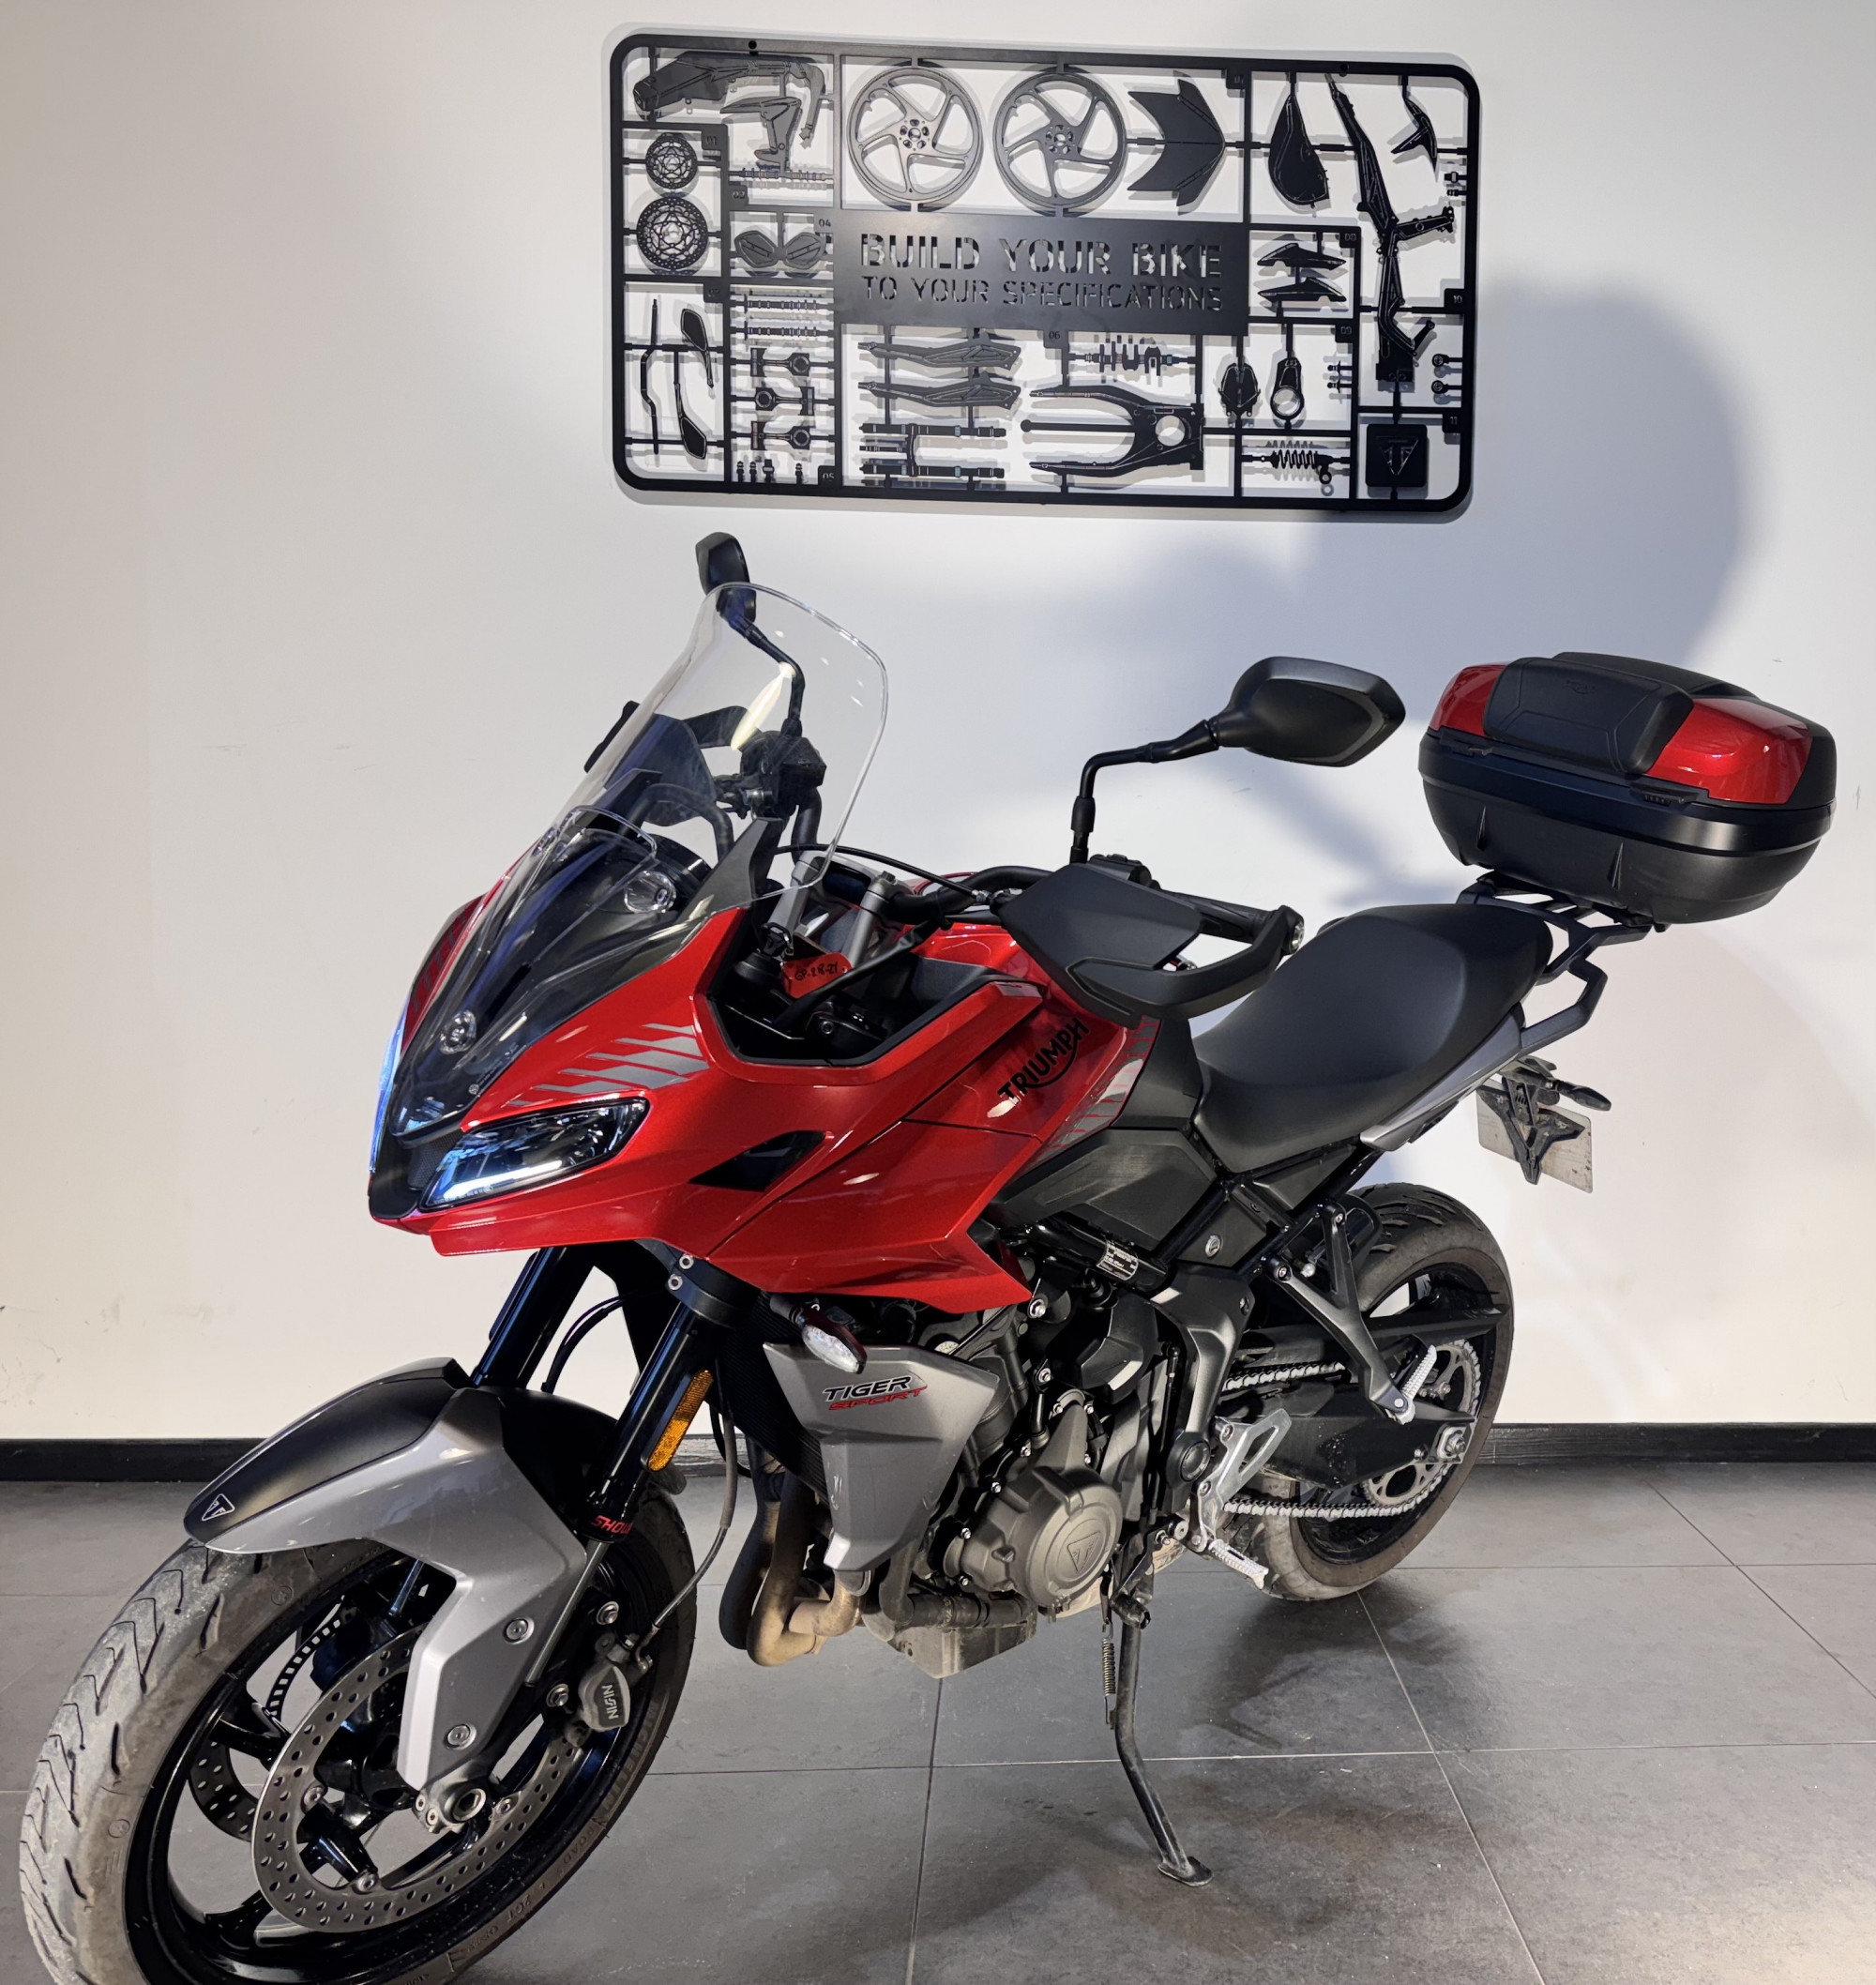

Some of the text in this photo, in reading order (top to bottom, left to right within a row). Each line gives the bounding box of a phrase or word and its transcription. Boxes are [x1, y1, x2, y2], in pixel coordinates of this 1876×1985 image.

[818, 218, 832, 227] 04
[861, 234, 1221, 278] BUILD YOUR BIKE
[861, 275, 1222, 311] TO YOUR SPECIFICATIONS
[1453, 295, 1463, 304] 10
[1048, 330, 1061, 340] 06
[997, 1017, 1090, 1101] TRIUMPH
[824, 1375, 912, 1402] TIGER
[829, 1386, 928, 1410] SPORT
[601, 1684, 619, 1720] NISSIN
